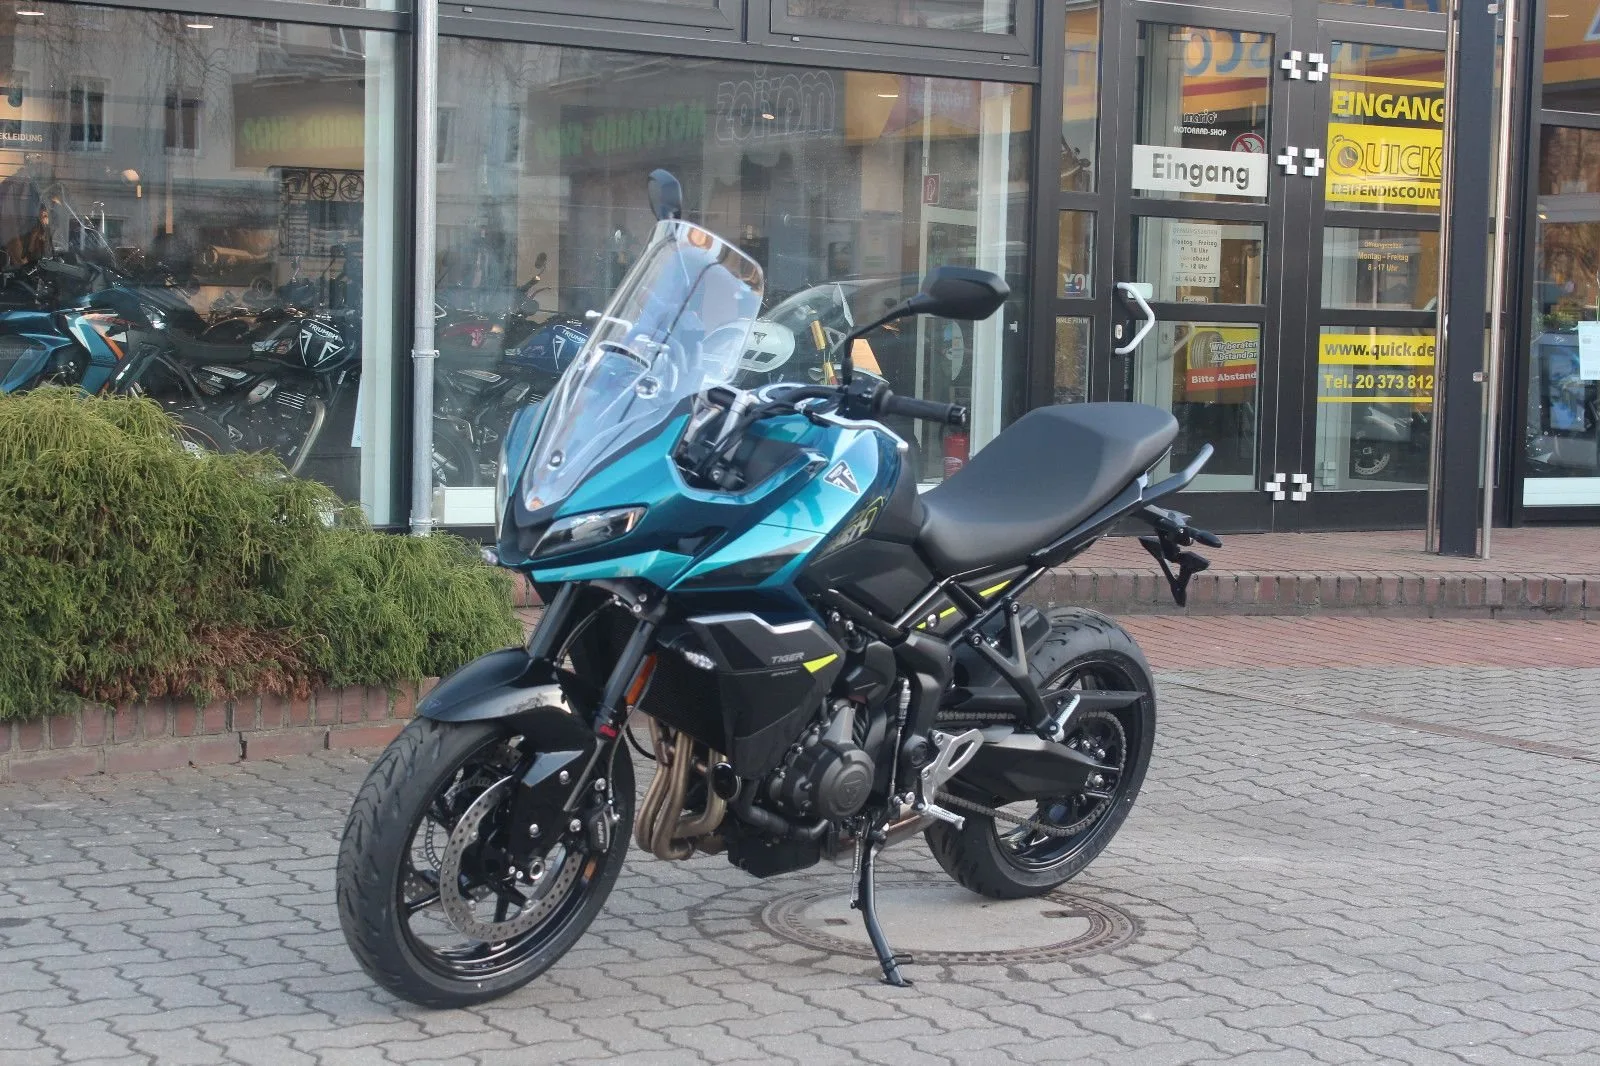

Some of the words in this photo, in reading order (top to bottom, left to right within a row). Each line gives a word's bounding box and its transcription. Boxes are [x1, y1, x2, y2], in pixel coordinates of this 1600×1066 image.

[1331, 90, 1444, 123] EINGANG
[1329, 137, 1443, 179] QUICK
[1152, 153, 1250, 190] Eingang
[1331, 183, 1441, 200] REIFENDISCOUNT
[561, 328, 587, 342] TRIUMP
[1324, 342, 1435, 361] www.quick.de
[1191, 375, 1215, 384] Bitte
[1217, 371, 1257, 382] Abstand
[1324, 374, 1353, 389] Tel.
[1355, 374, 1375, 389] 20
[1377, 374, 1404, 389] 373
[1407, 374, 1434, 389] 812
[771, 652, 805, 664] TIGER
